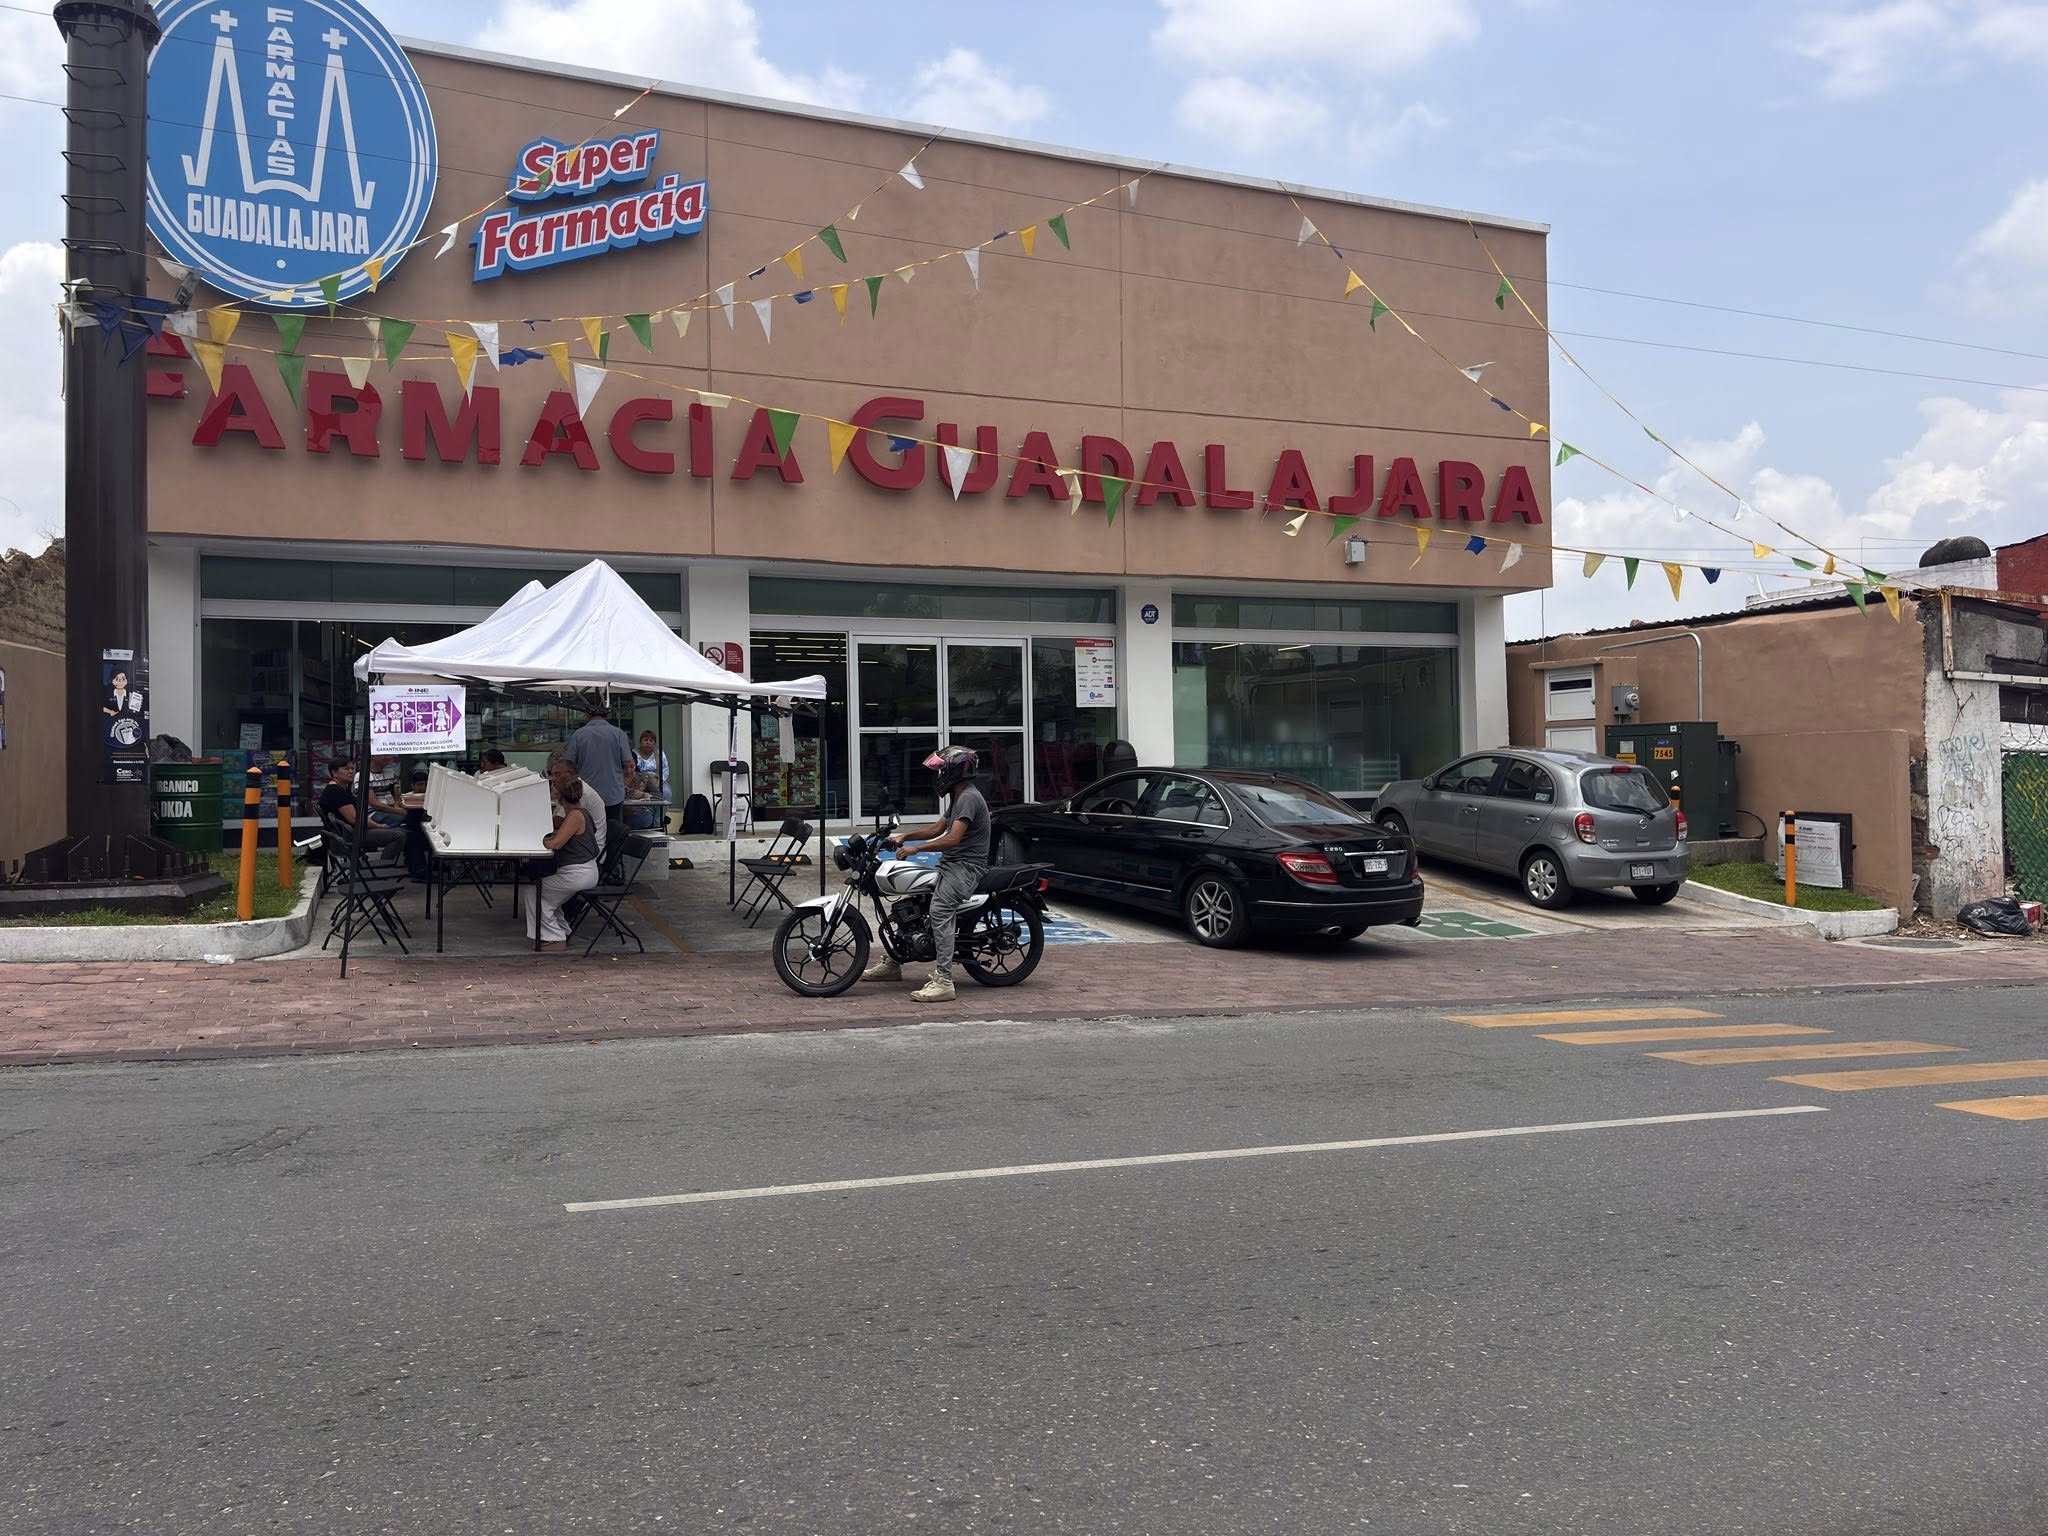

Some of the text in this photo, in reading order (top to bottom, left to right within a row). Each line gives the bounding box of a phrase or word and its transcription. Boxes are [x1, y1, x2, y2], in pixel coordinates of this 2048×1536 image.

[266, 7, 295, 176] FARMACIAS
[515, 132, 658, 193] Super
[187, 193, 370, 255] GUADALAJARA
[478, 173, 706, 270] Farmacia
[154, 780, 199, 793] RGANICO
